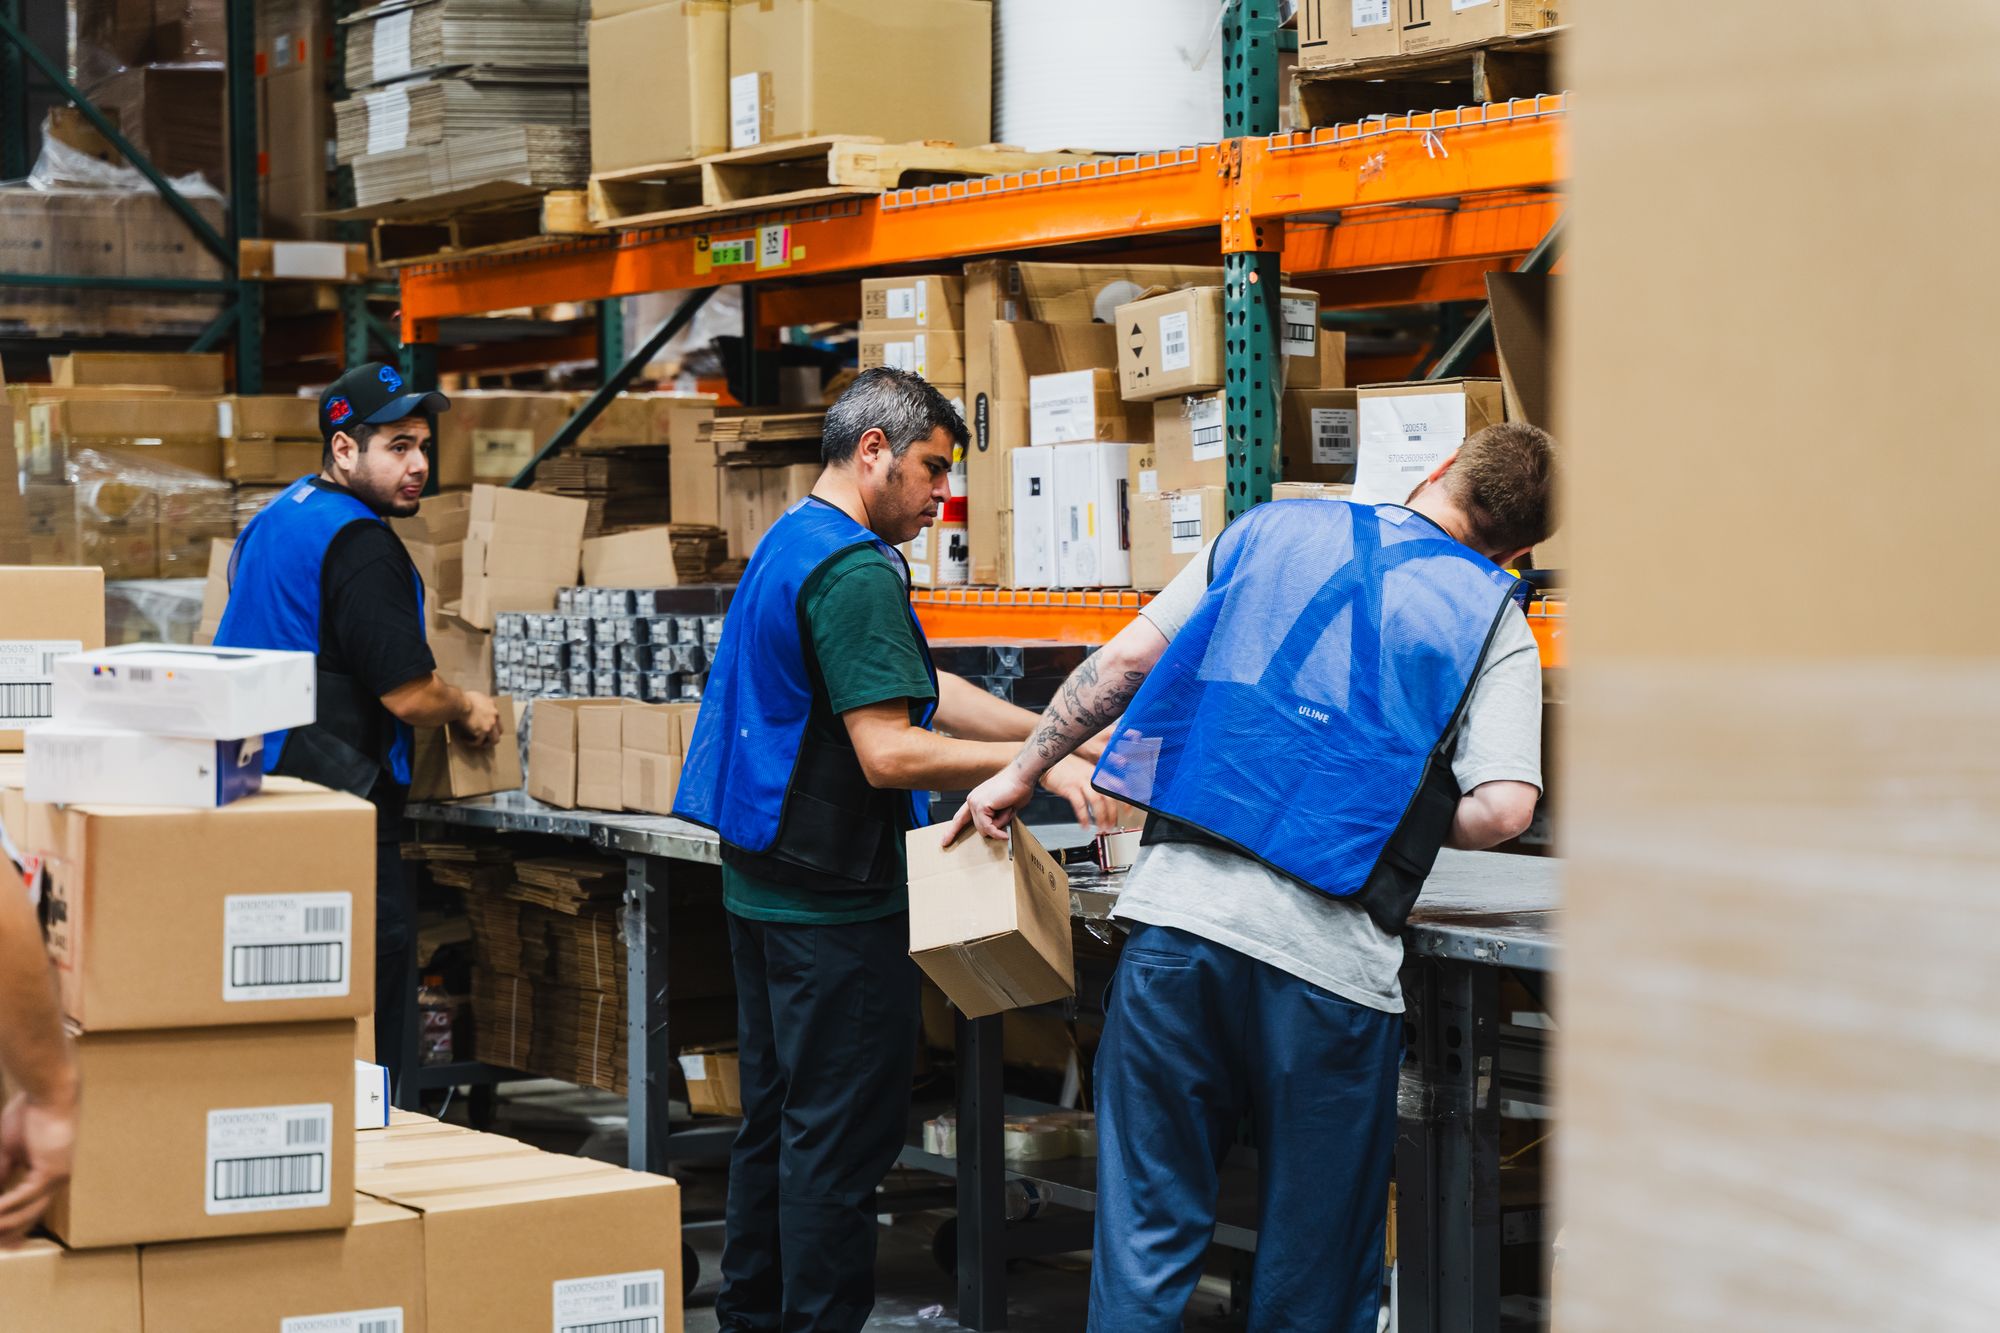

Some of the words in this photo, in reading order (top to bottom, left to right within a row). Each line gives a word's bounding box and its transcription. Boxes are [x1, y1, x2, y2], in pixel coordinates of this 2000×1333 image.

[977, 397, 986, 420] Tiny
[978, 422, 986, 447] Love
[1298, 705, 1328, 724] ULINE
